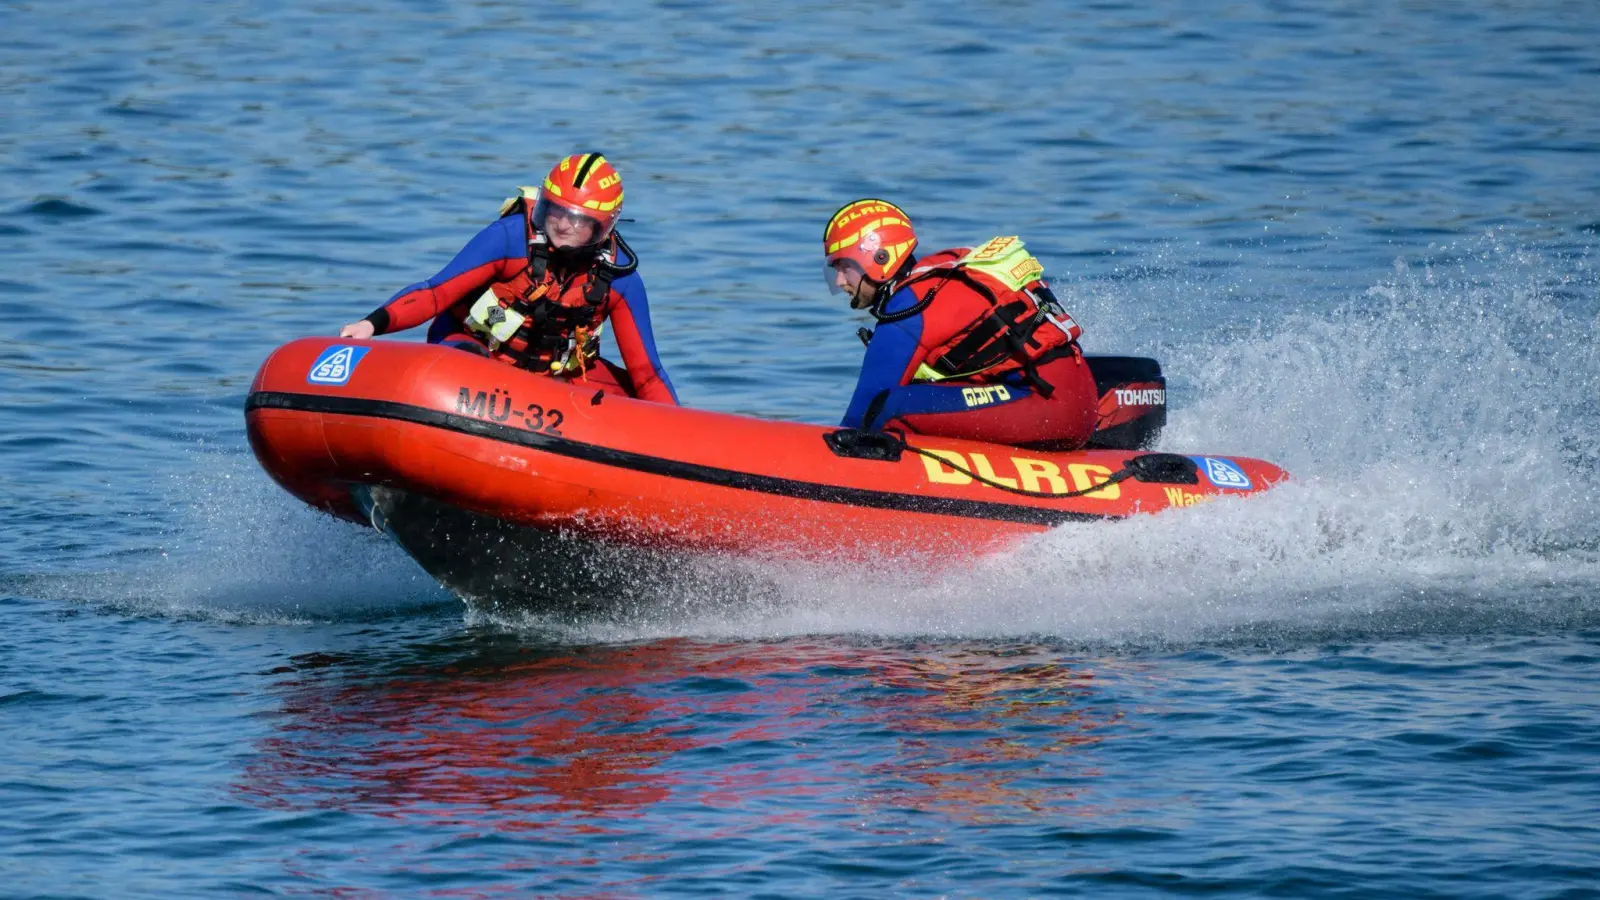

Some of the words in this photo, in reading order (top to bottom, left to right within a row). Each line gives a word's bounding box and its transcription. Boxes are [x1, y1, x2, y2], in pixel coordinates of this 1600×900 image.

[837, 205, 889, 229] DLRG
[456, 386, 564, 437] MÜ-32
[1115, 389, 1166, 407] TOHATSU
[919, 448, 1121, 500] DLRG
